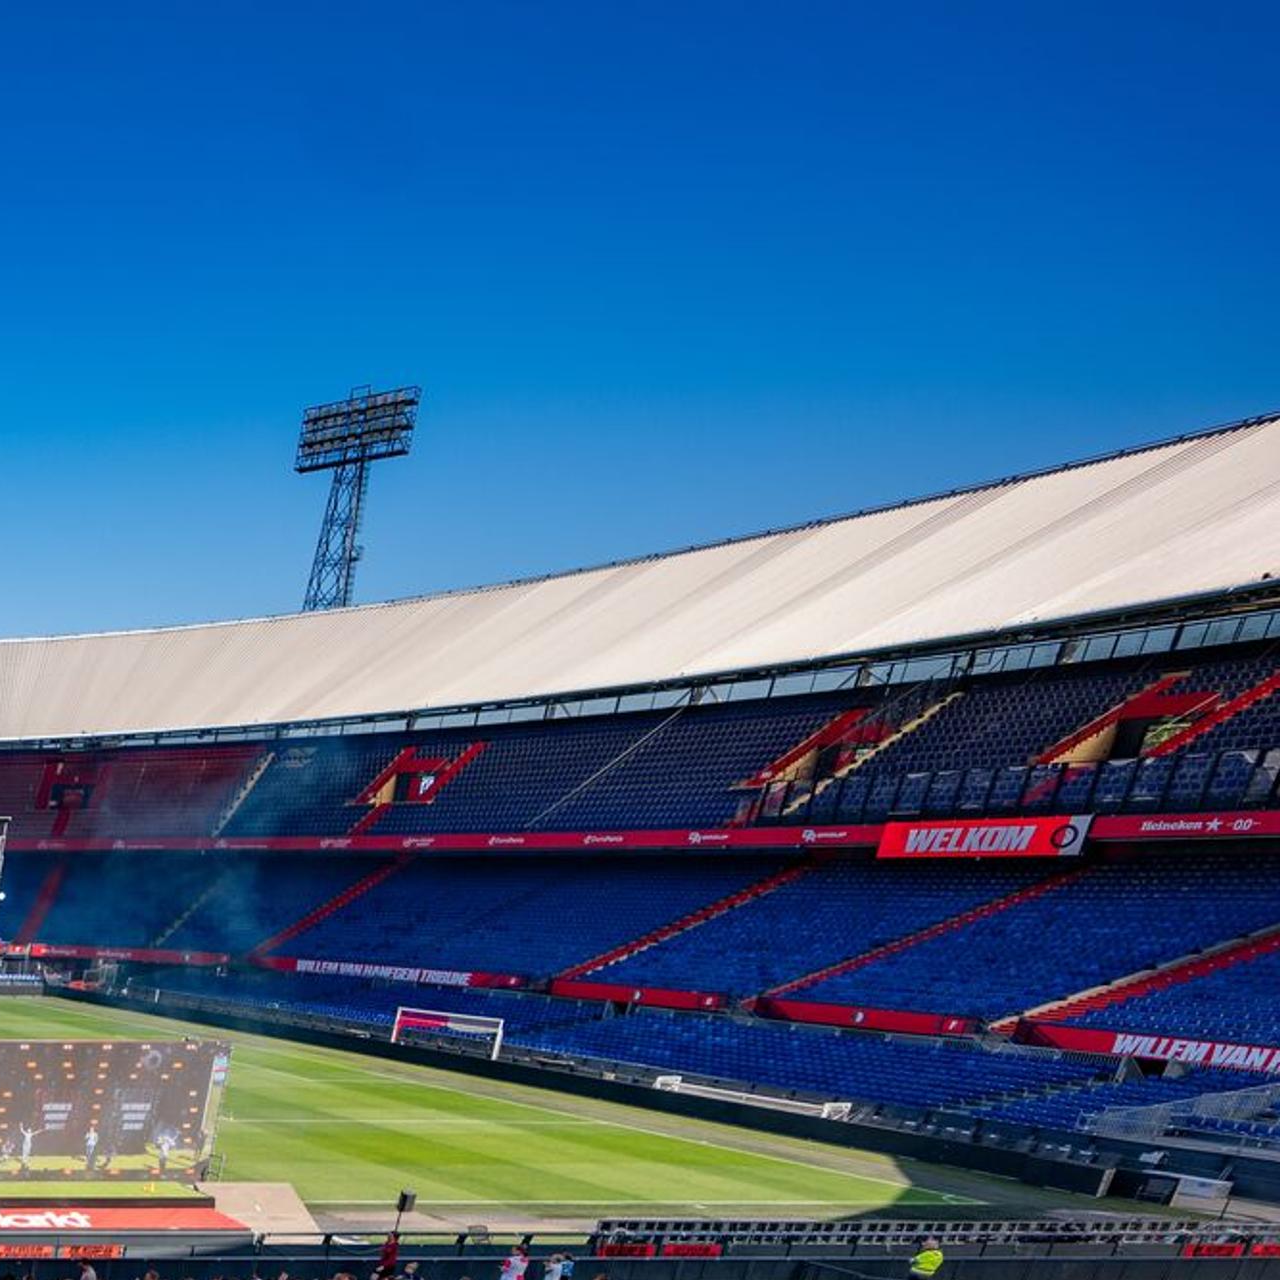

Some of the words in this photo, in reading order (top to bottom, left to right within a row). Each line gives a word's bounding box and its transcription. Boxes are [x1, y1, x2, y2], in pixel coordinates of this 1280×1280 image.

[904, 825, 1038, 854] WELKOM
[1140, 821, 1203, 832] Heineken
[1112, 1033, 1212, 1062] WILLEM
[1209, 1044, 1271, 1071] VAN
